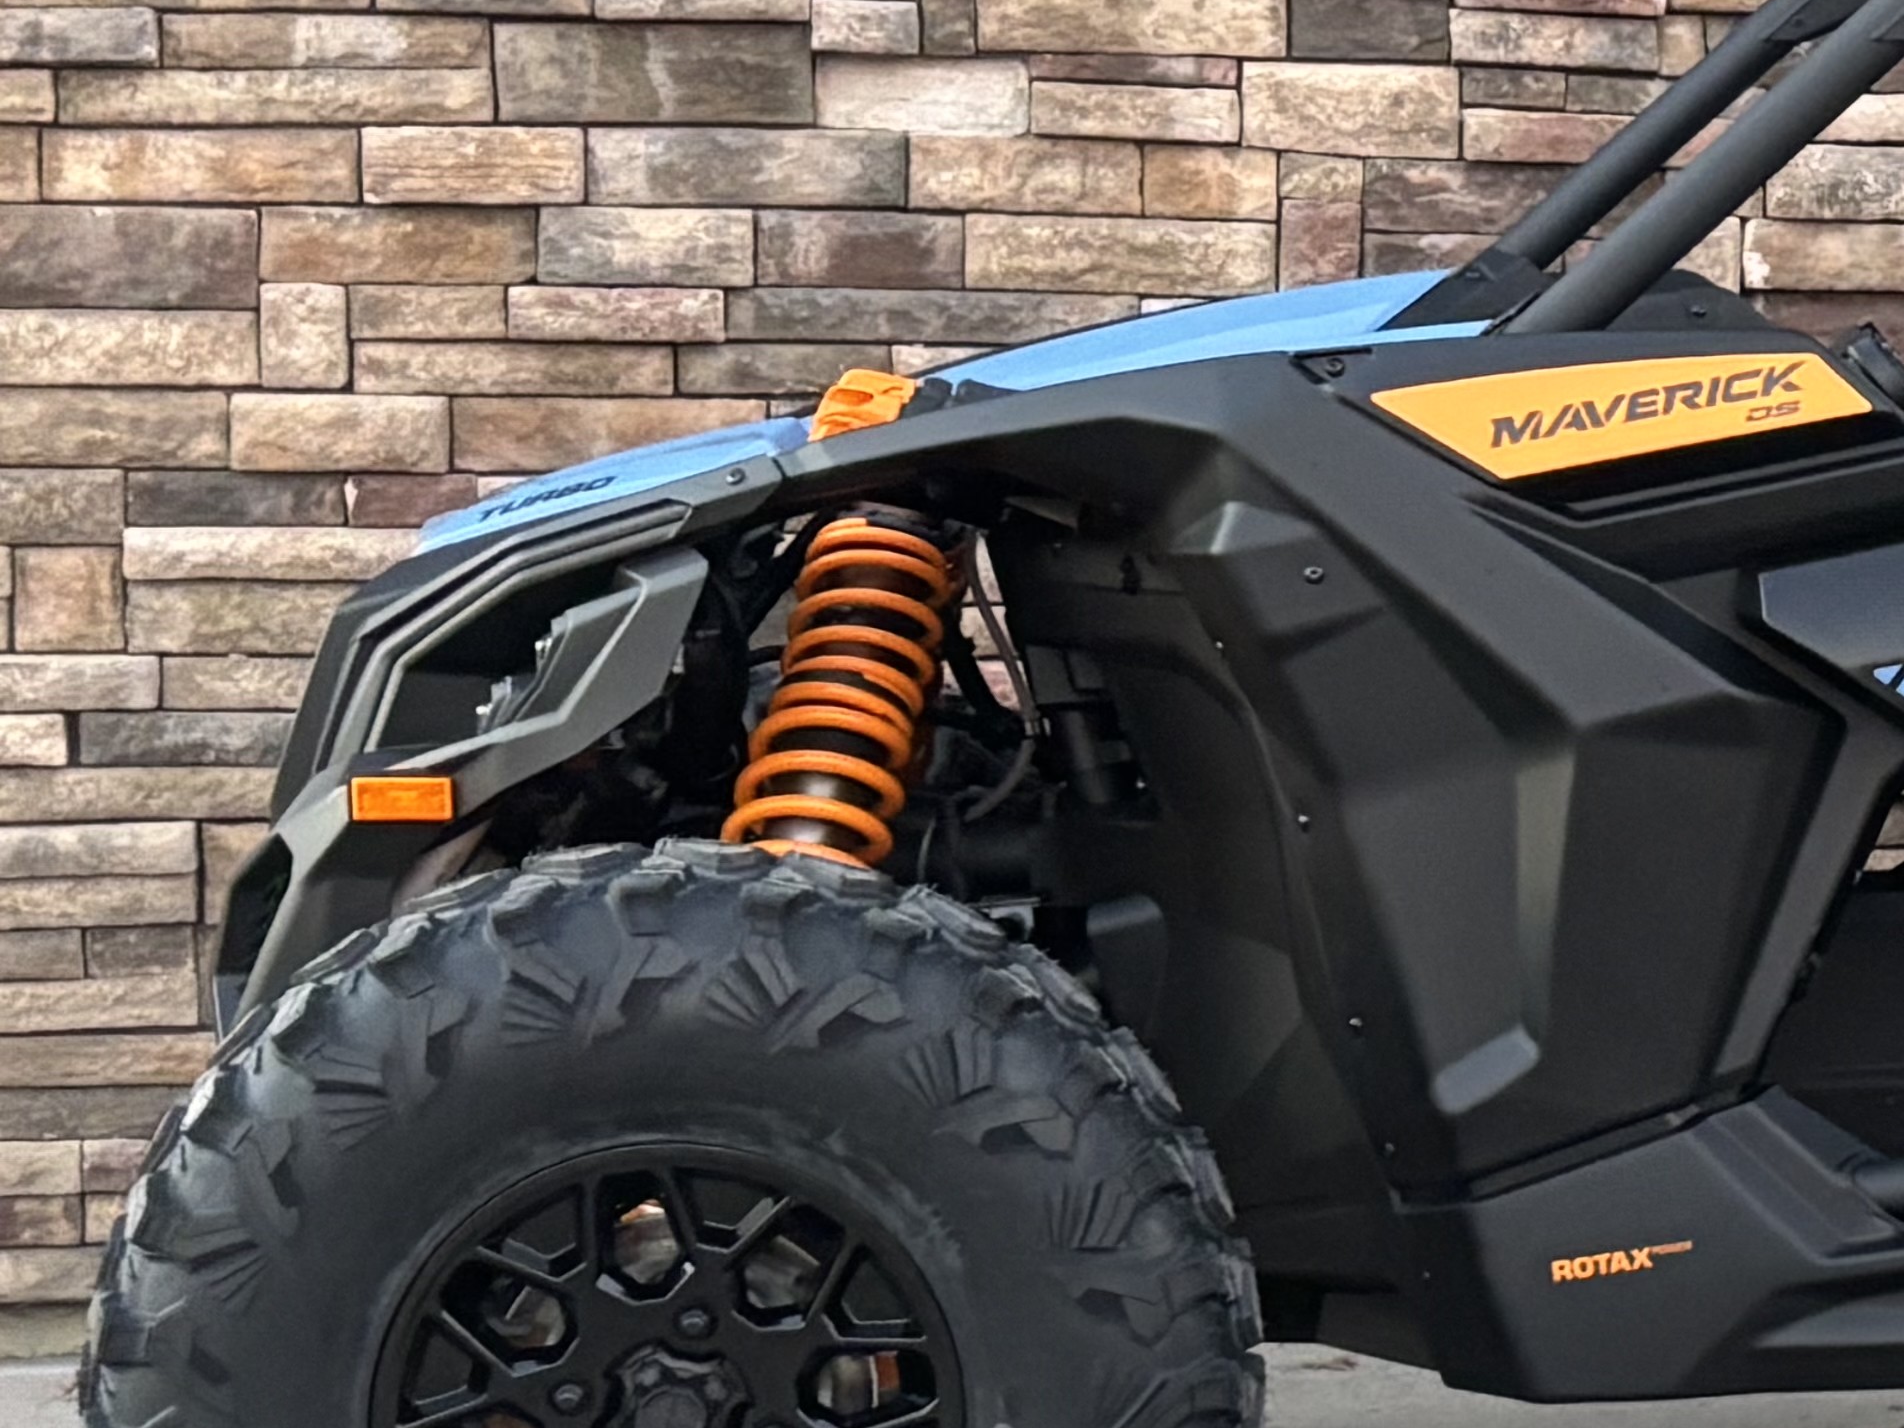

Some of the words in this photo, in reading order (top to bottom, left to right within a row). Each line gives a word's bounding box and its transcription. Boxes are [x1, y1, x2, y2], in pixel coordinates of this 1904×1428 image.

[1490, 361, 1806, 449] MAVERICK
[1743, 400, 1801, 423] DS
[478, 475, 618, 523] TURBO
[1550, 1247, 1653, 1283] ROTAX
